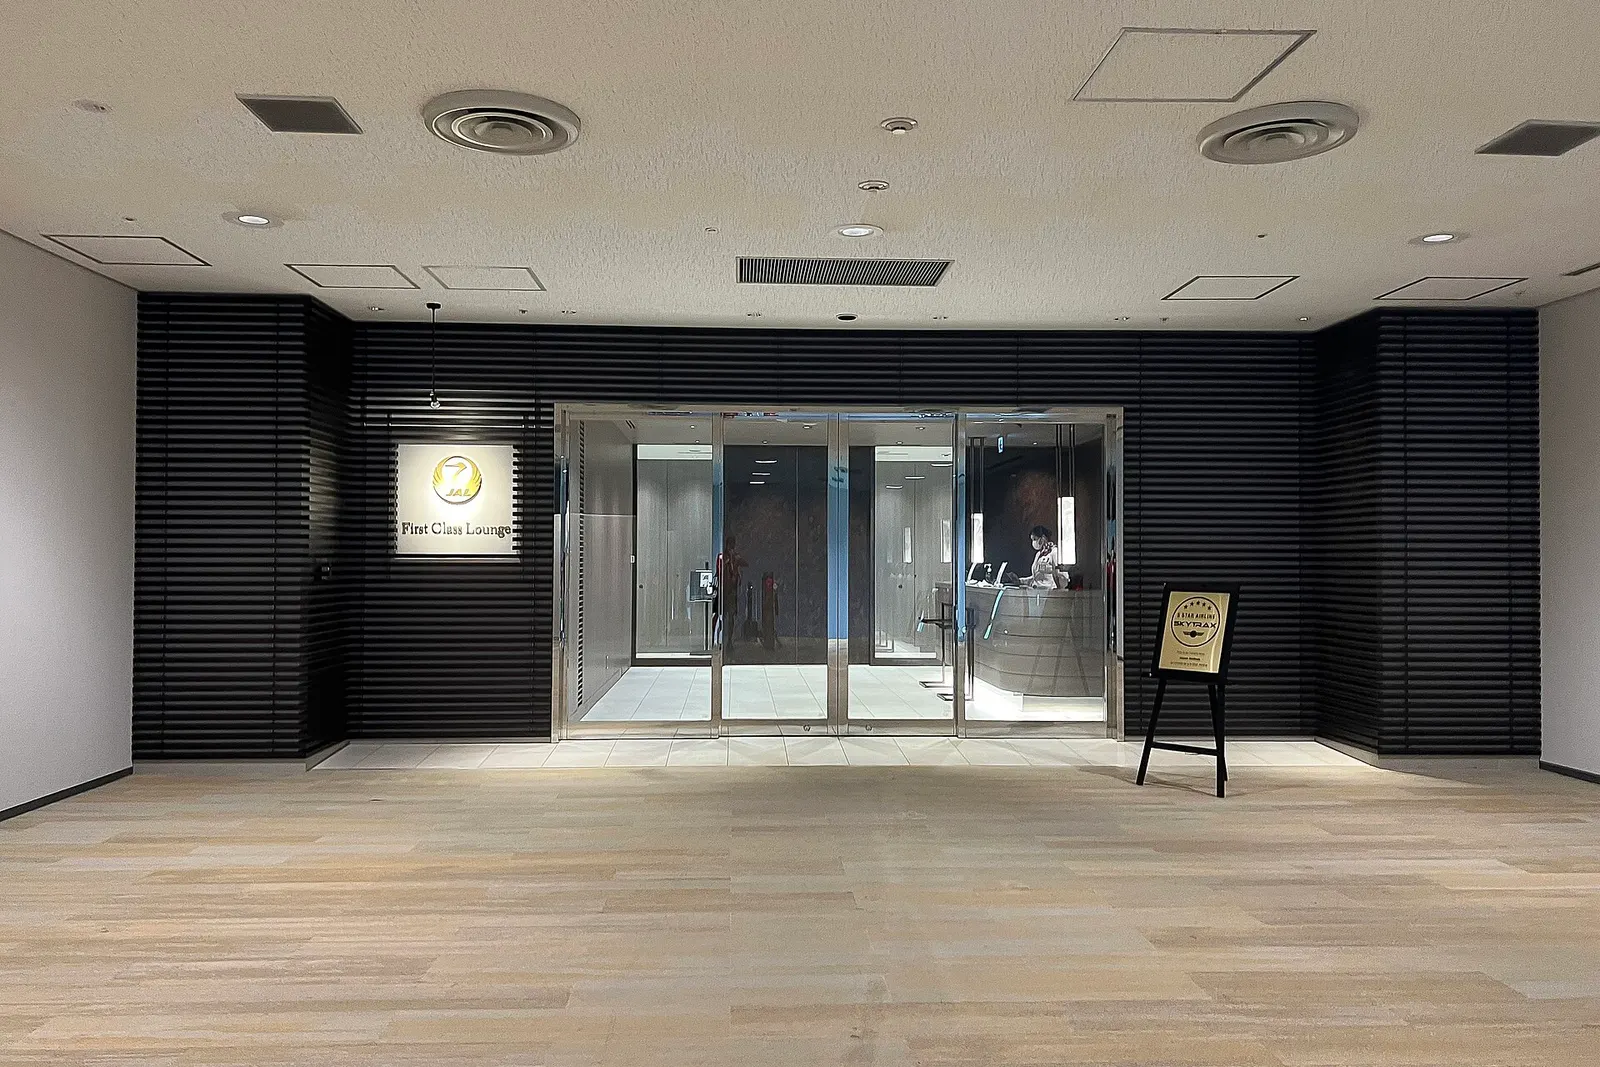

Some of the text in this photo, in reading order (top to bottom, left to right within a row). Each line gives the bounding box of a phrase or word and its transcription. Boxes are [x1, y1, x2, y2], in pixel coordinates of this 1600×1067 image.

[446, 488, 471, 497] JAL
[401, 522, 511, 538] First Class Lounge
